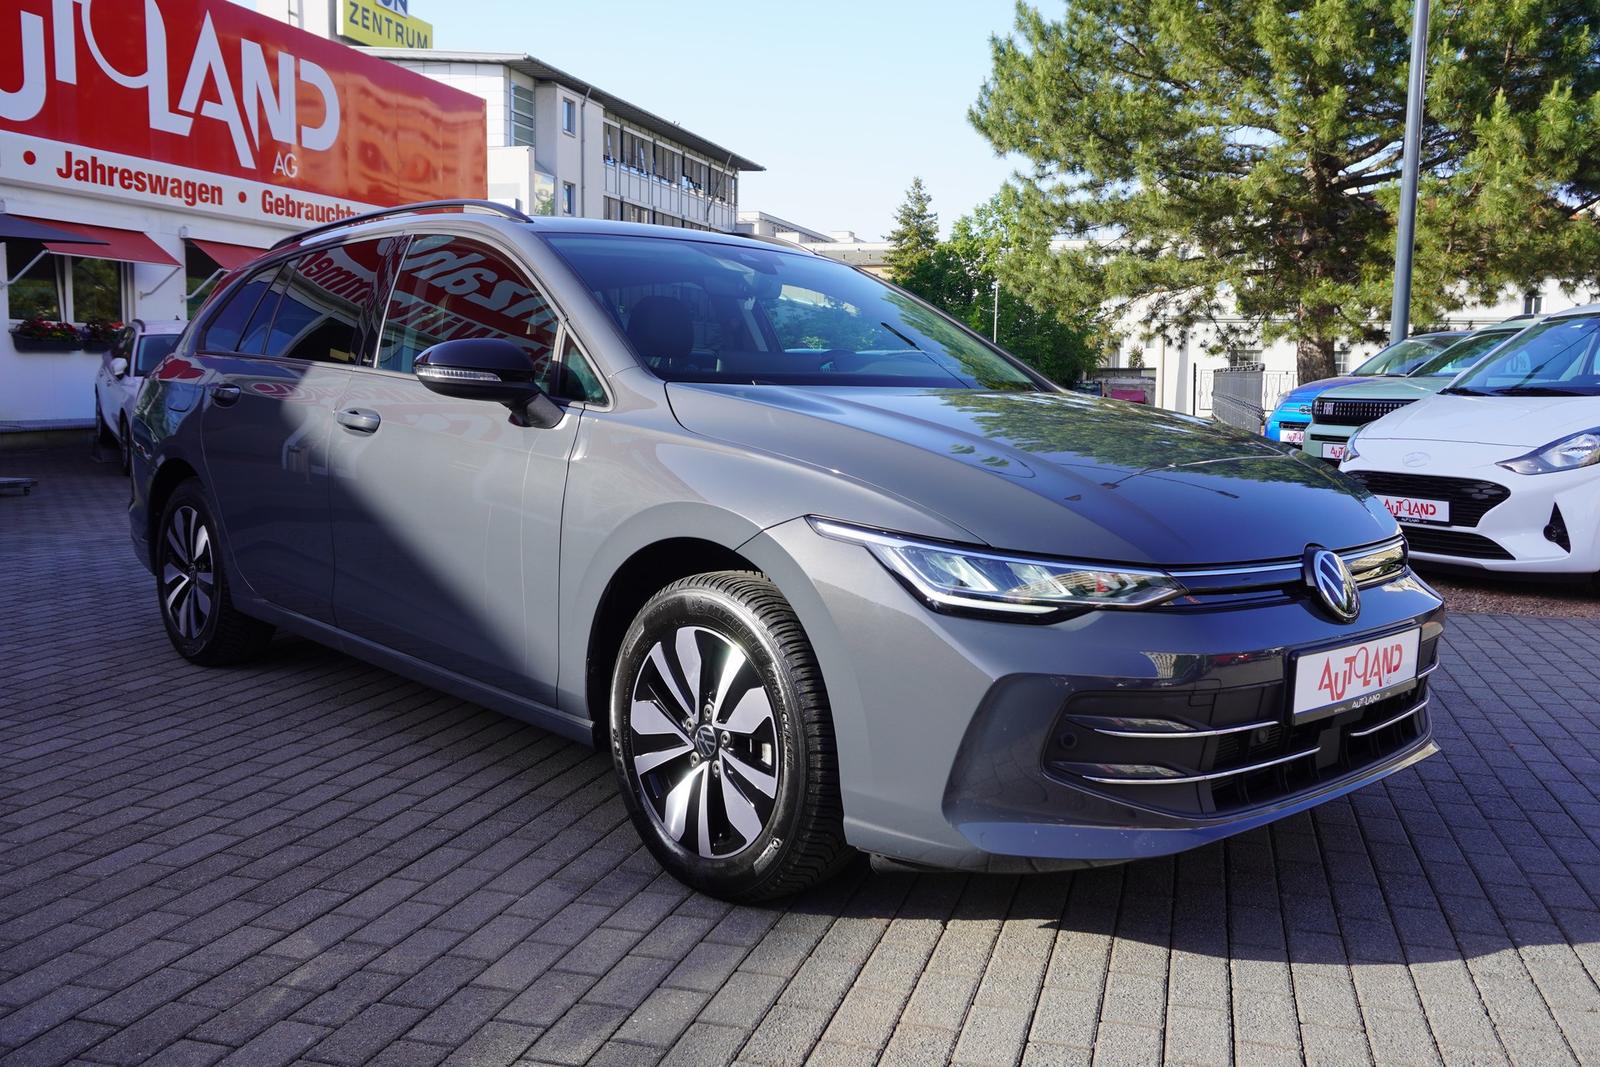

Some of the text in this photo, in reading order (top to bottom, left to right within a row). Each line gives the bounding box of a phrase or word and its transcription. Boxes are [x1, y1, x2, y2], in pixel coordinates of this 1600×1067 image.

[349, 2, 427, 48] ZENTRUM
[273, 151, 298, 178] AG
[56, 150, 360, 223] Jahreswagen Gebraucht
[1384, 498, 1436, 518] AUTOLAND
[1318, 644, 1403, 701] AUTOLAND
[1351, 693, 1381, 709] AUTOLAND
